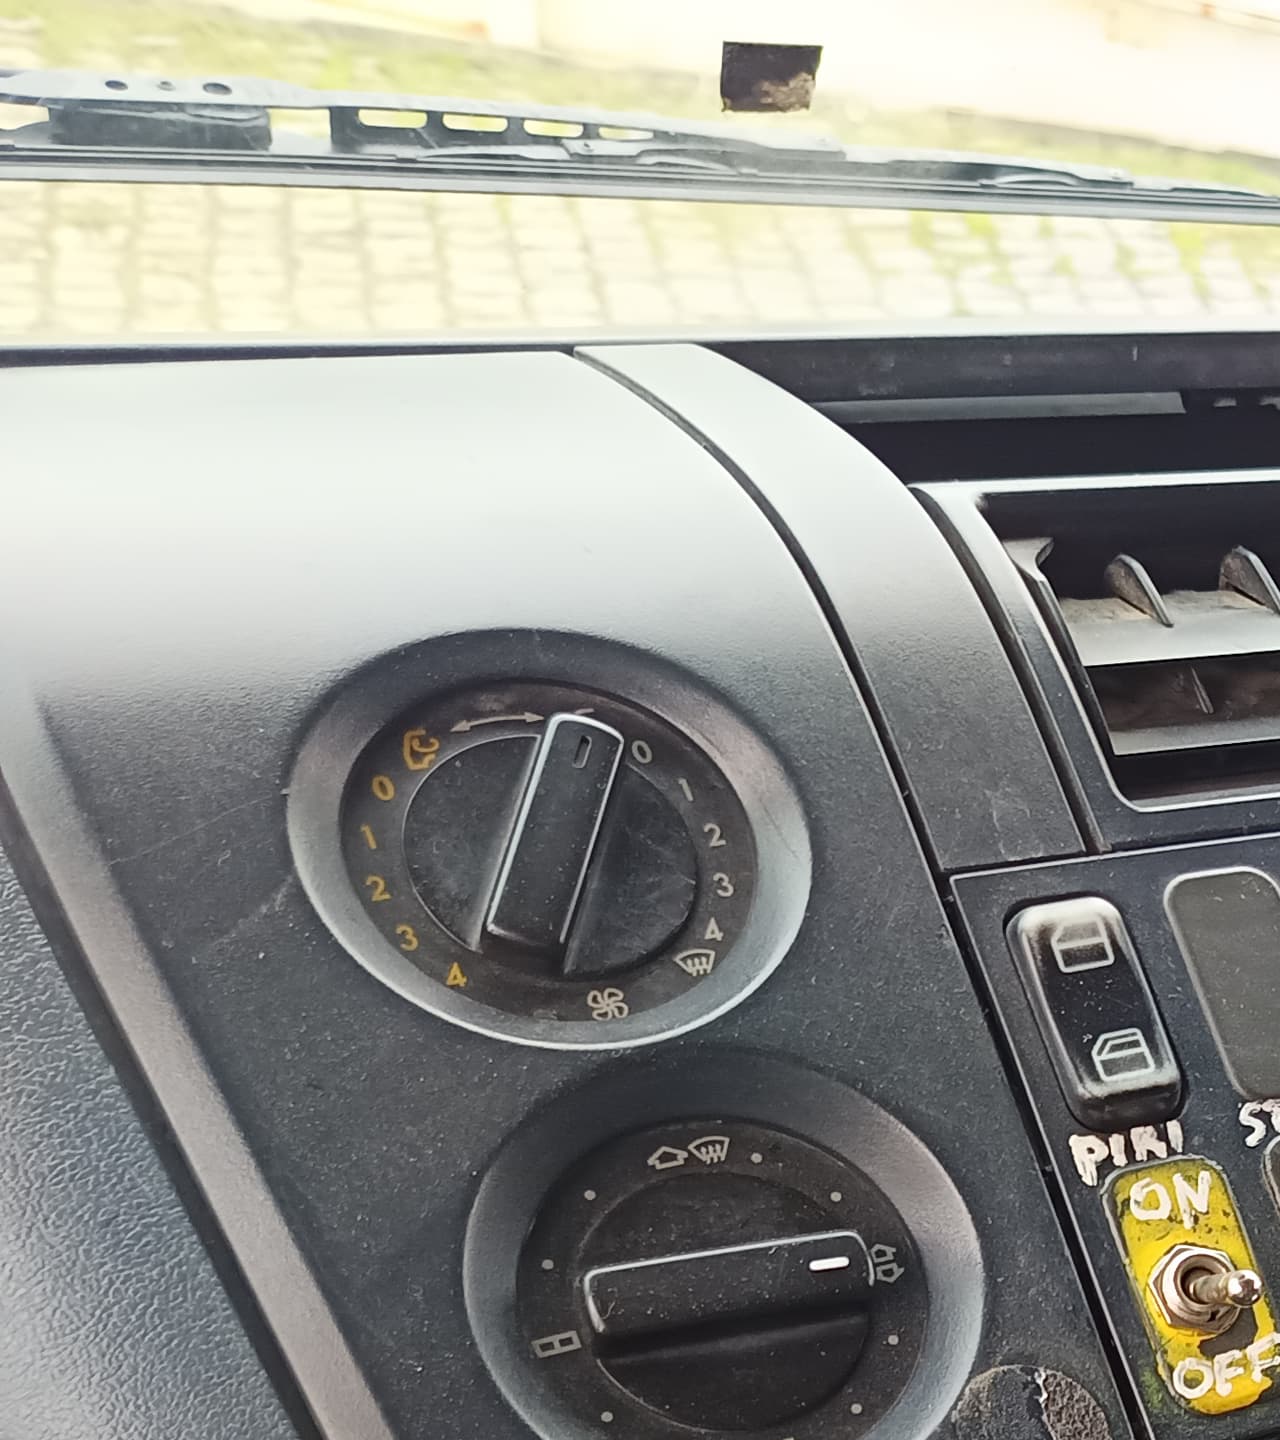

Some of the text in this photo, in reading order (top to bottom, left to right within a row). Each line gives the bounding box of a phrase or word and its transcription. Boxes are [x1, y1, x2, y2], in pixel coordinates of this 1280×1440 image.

[631, 740, 653, 764] 0
[371, 775, 396, 801] 0
[359, 824, 378, 850] 1
[703, 823, 726, 848] 2
[365, 876, 391, 901] 2
[712, 873, 734, 897] 3
[396, 925, 420, 952] 3
[703, 917, 724, 942] 4
[445, 962, 468, 988] 4
[1129, 1170, 1212, 1230] ON
